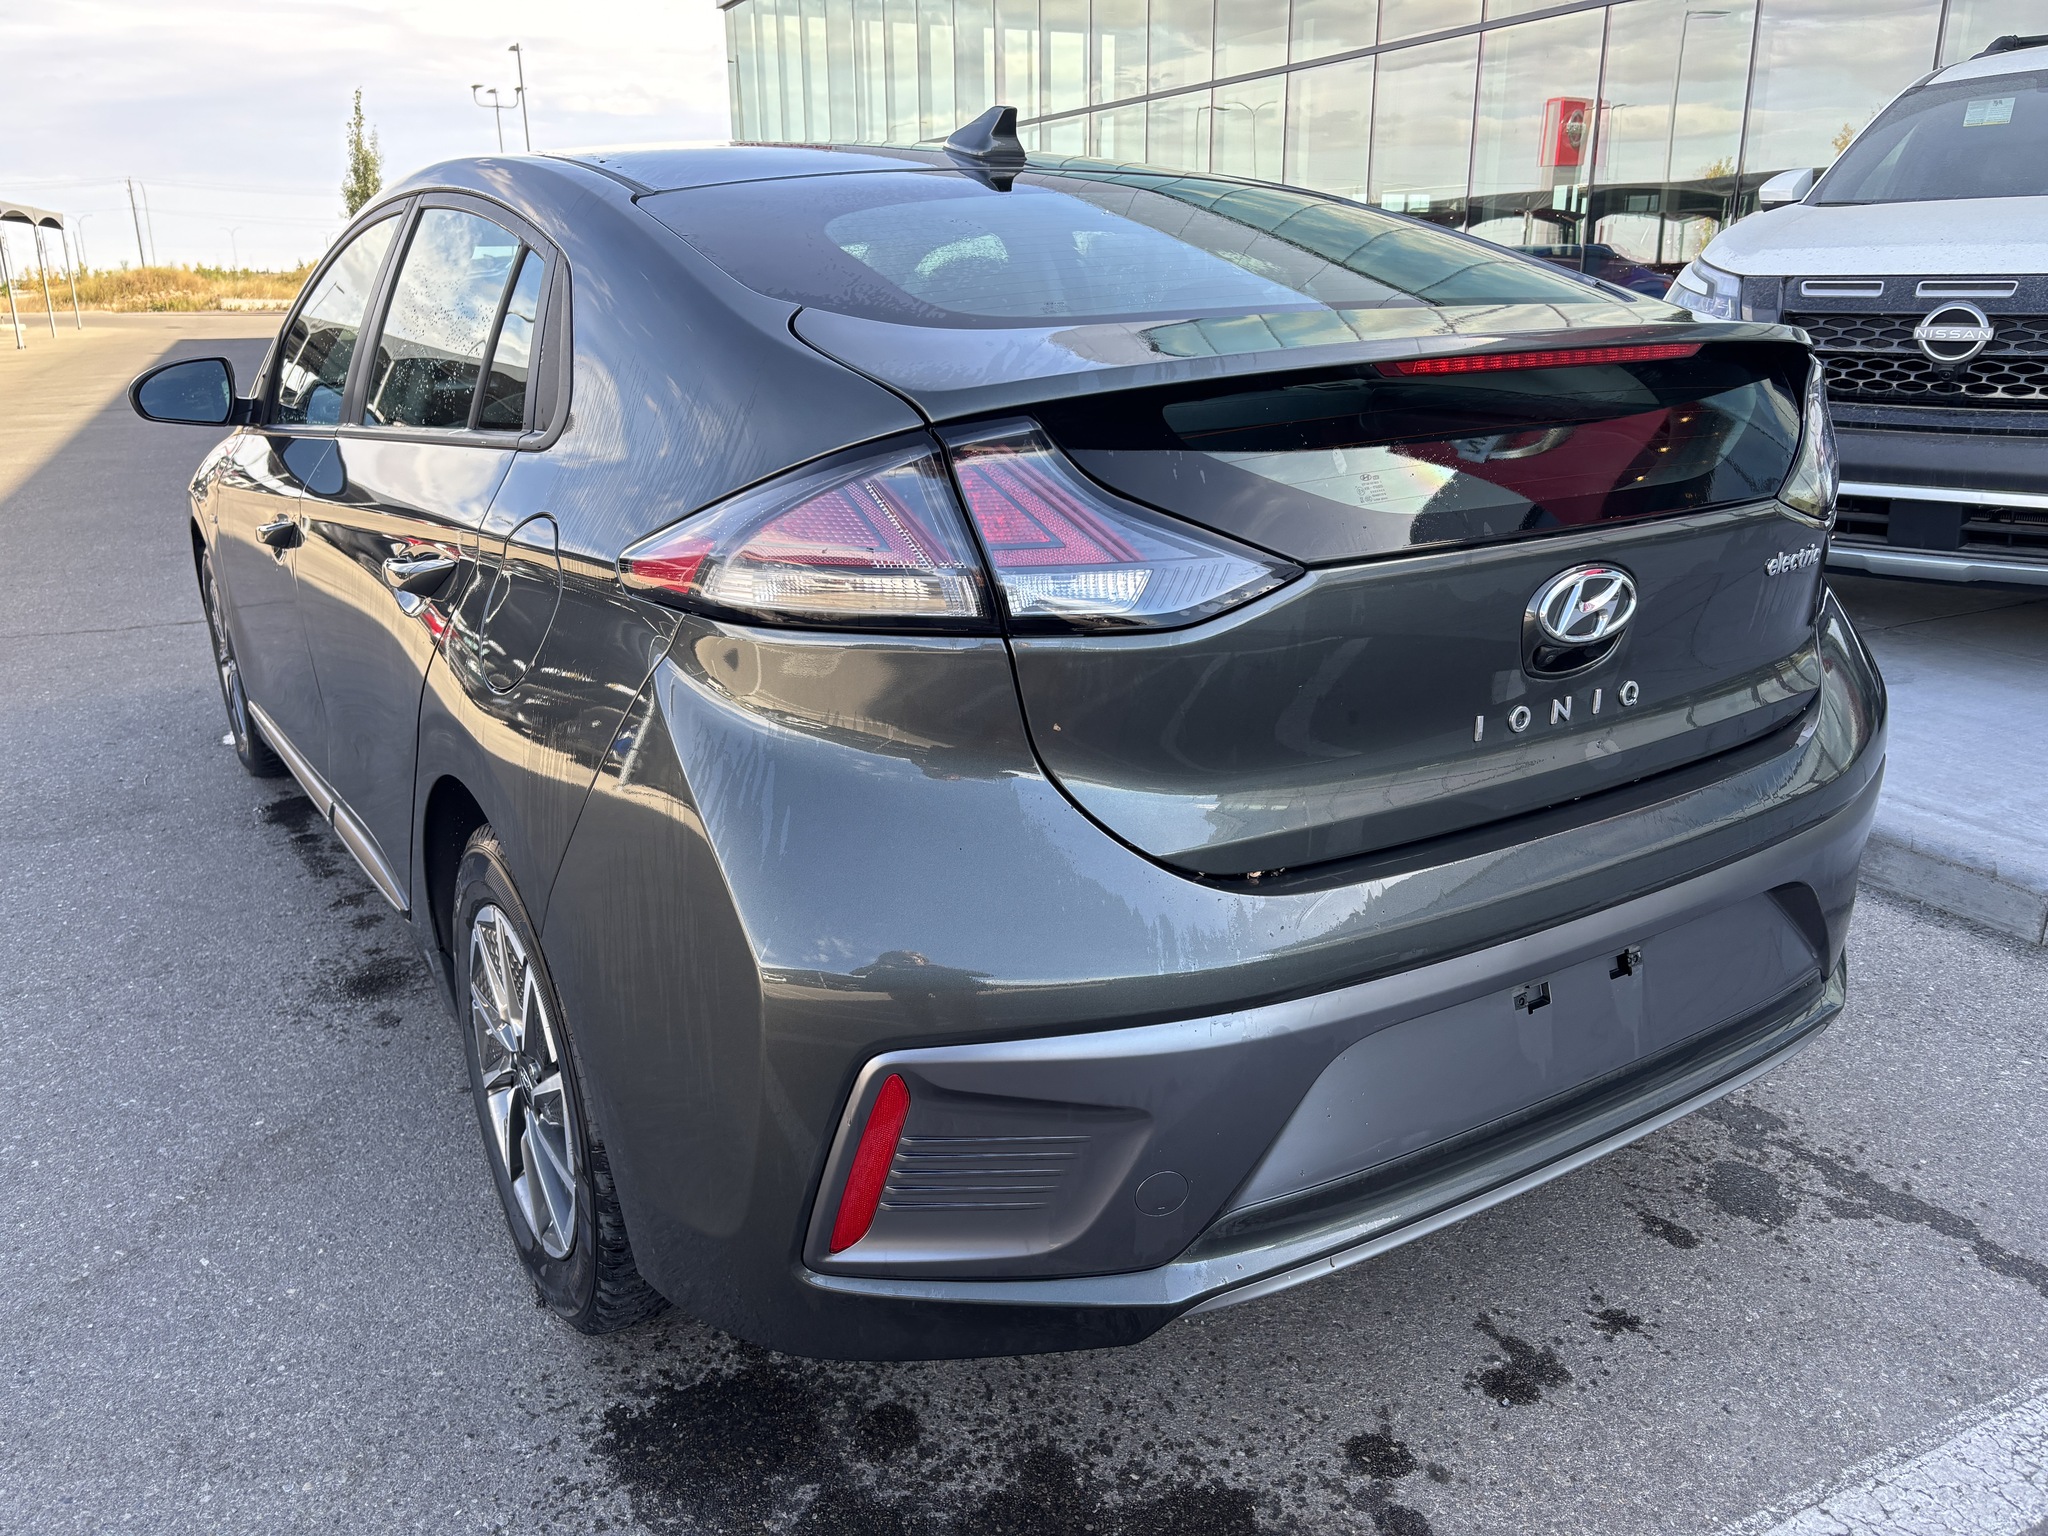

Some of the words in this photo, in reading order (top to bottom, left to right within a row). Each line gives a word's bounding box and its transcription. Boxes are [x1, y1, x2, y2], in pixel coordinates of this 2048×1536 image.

[1915, 329, 1991, 339] NISSAN
[1765, 543, 1821, 577] electric
[1473, 680, 1640, 742] IONIQ
